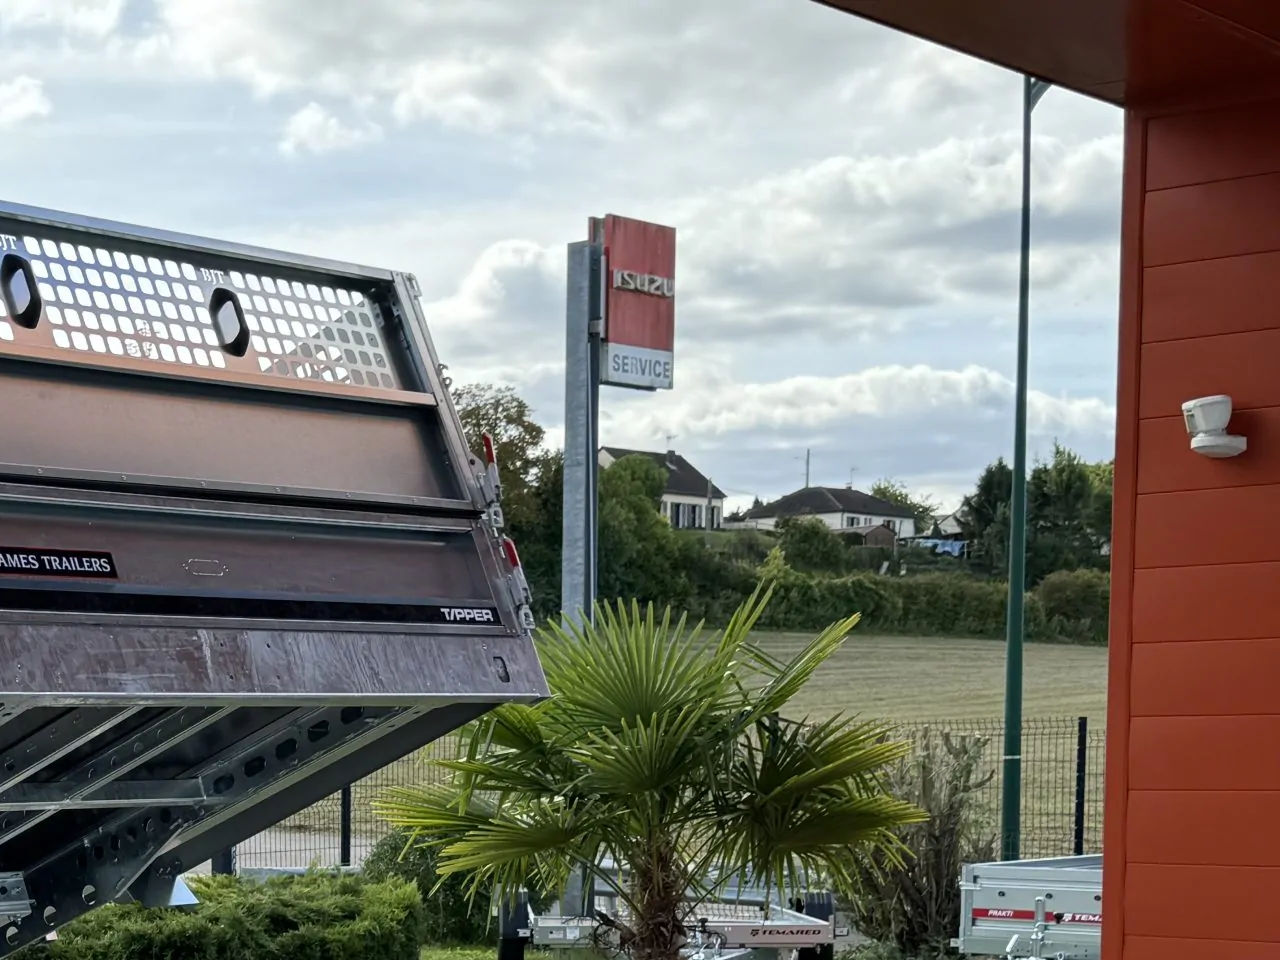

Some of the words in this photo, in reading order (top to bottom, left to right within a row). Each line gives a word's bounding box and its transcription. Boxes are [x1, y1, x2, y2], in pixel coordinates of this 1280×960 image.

[200, 267, 224, 285] BJT
[613, 269, 675, 295] ISUZU
[612, 353, 670, 379] SERVICE
[41, 556, 111, 572] TRAILERS
[988, 909, 1014, 917] PRAKTI
[762, 928, 822, 936] TEMARED
